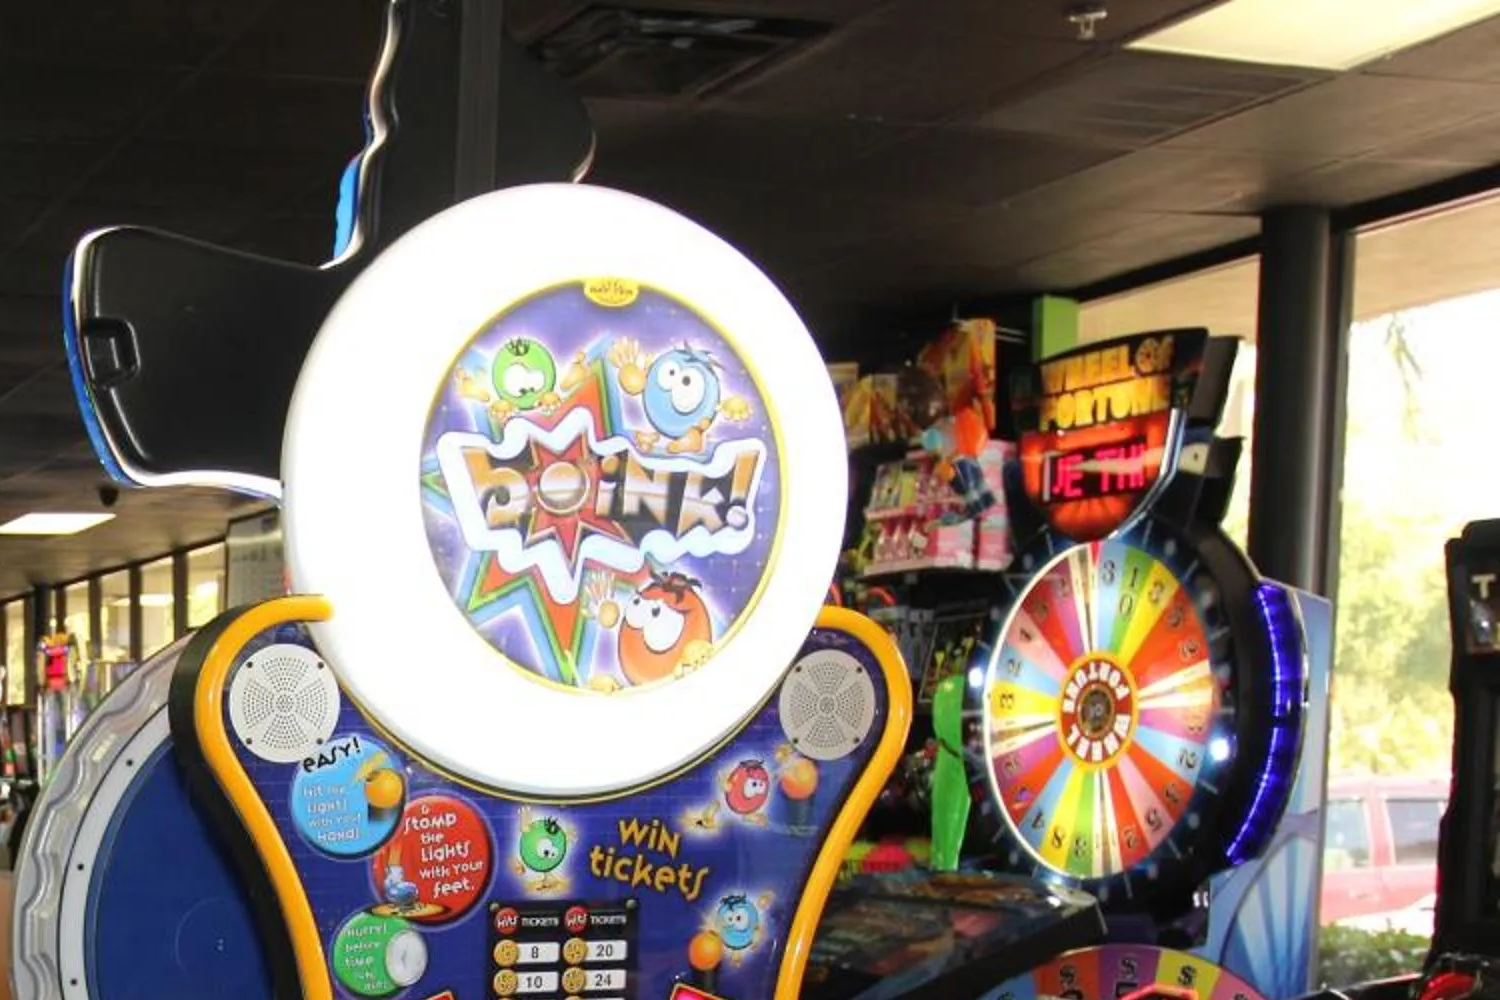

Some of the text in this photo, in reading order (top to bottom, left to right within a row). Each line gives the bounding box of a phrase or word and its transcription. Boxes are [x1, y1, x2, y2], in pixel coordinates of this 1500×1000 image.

[1101, 559, 1116, 586] 3
[1178, 750, 1198, 770] 2
[1145, 808, 1163, 832] 5
[1050, 824, 1066, 849] 8
[530, 945, 540, 960] 8
[595, 943, 614, 958] 20
[526, 975, 543, 989] 10
[594, 973, 613, 987] 24
